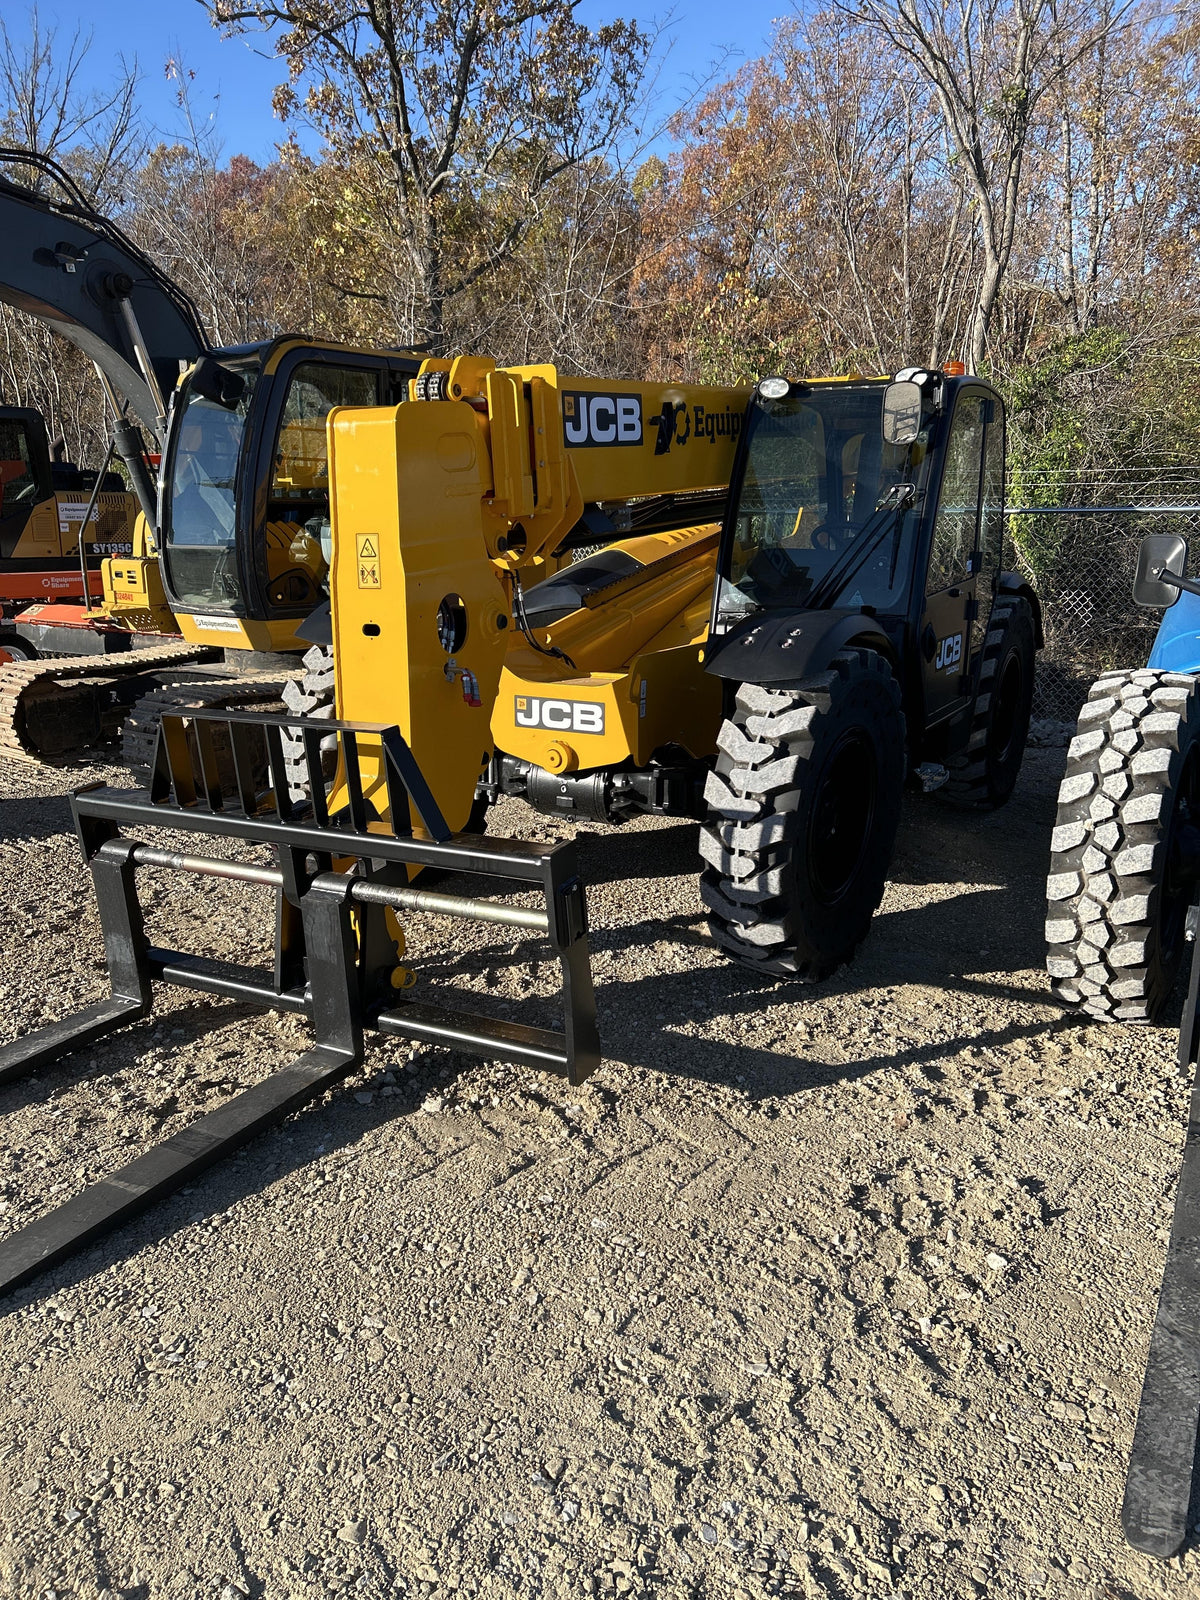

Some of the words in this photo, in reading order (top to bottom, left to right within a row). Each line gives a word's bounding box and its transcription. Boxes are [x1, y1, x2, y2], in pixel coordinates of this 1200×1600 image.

[565, 396, 642, 443] JCB
[92, 543, 132, 554] SY135C
[935, 634, 962, 670] JCB
[516, 699, 604, 732] JCB
